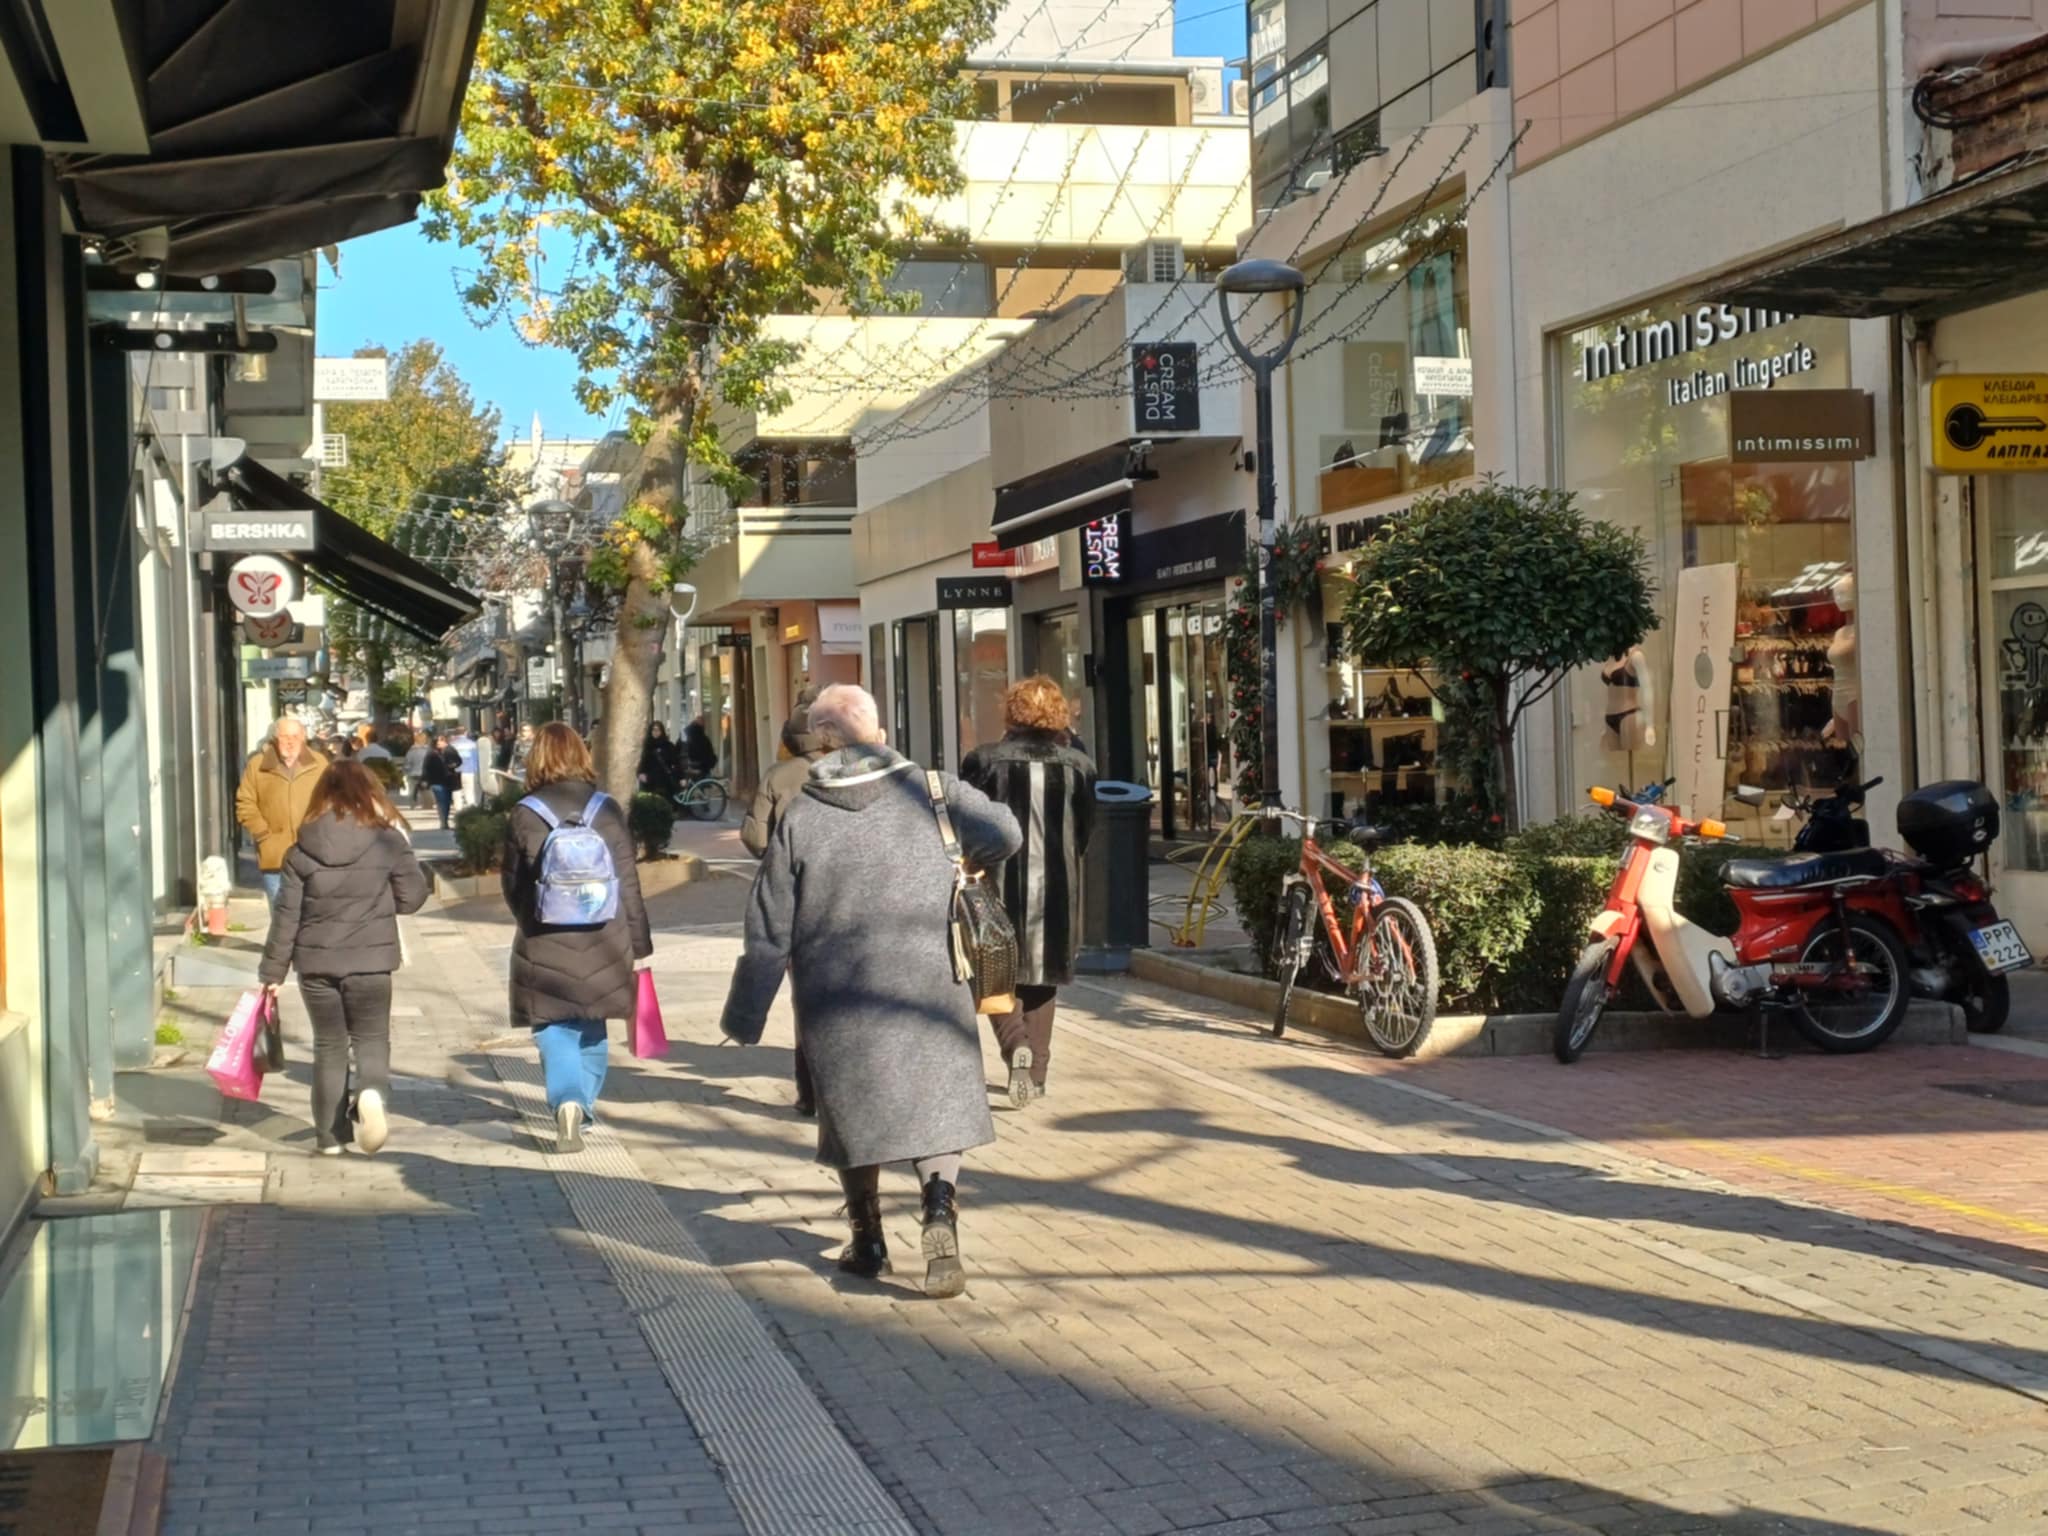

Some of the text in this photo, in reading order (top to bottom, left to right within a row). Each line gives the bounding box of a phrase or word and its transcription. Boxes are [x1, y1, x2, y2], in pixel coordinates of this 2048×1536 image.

[1582, 301, 1799, 383] intimissi
[1667, 342, 1816, 407] Italian lingerie
[1143, 370, 1161, 420] DUST
[1159, 353, 1176, 420] CREAM
[1983, 380, 2036, 392] ΚΛΕΙΔΙΑ
[1737, 435, 1860, 451] intimissimi
[210, 523, 307, 540] BERSHKA
[1085, 527, 1104, 577] DUST
[943, 586, 1004, 599] LYNNE
[1982, 925, 2013, 945] PPP
[1993, 943, 2027, 963] 222
